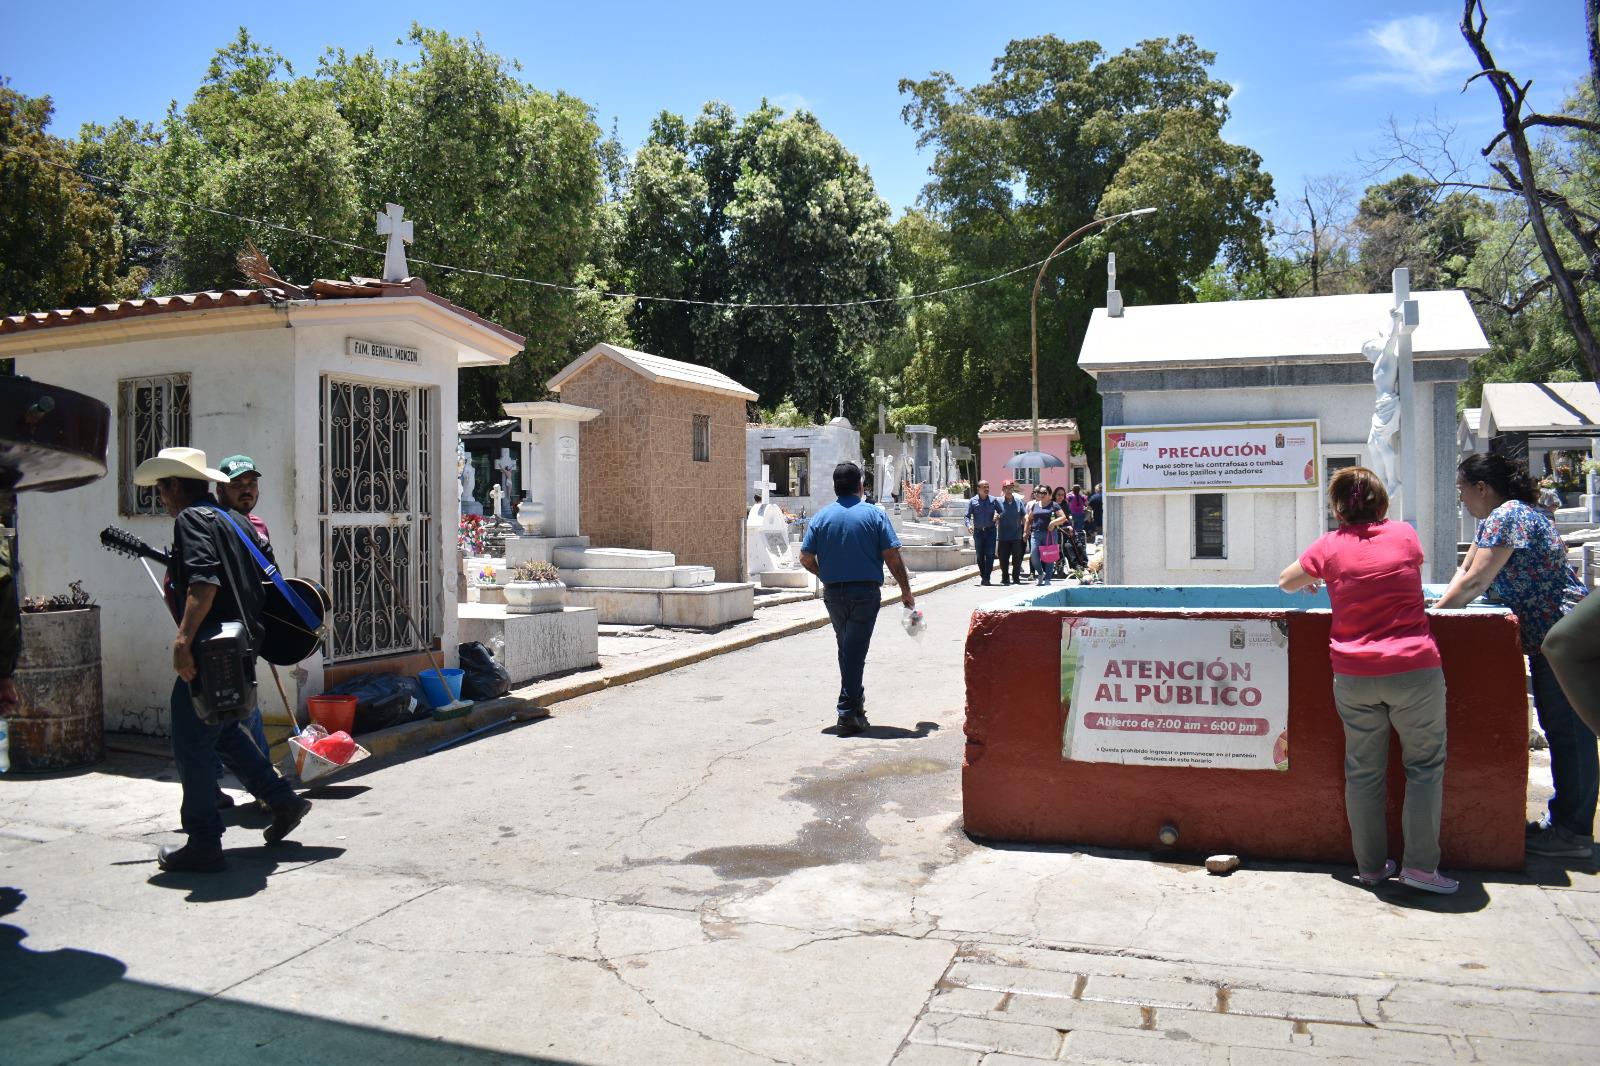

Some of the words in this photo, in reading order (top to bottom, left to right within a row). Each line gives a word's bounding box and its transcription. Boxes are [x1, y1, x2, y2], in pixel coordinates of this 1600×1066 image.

[371, 344, 393, 359] BERNAL
[1158, 441, 1267, 459] PRECAUCIÓN
[1155, 463, 1172, 471] pase
[1205, 460, 1248, 468] contrafosas
[1255, 459, 1284, 467] tumbas
[1189, 468, 1217, 477] pasillos
[1224, 467, 1263, 475] andadores
[1103, 657, 1252, 682] ATENCIÓN
[1094, 683, 1129, 703] AL
[1134, 680, 1262, 707] PÚBLICO
[1096, 716, 1139, 728] Abierto
[1140, 718, 1155, 728] de
[1156, 718, 1182, 729] 7:00
[1183, 722, 1201, 730] am
[1210, 720, 1236, 731] 6:00
[1238, 721, 1257, 734] pm
[1100, 746, 1120, 754] Queda
[1120, 747, 1149, 756] prohibido
[1149, 748, 1174, 757] ingresar
